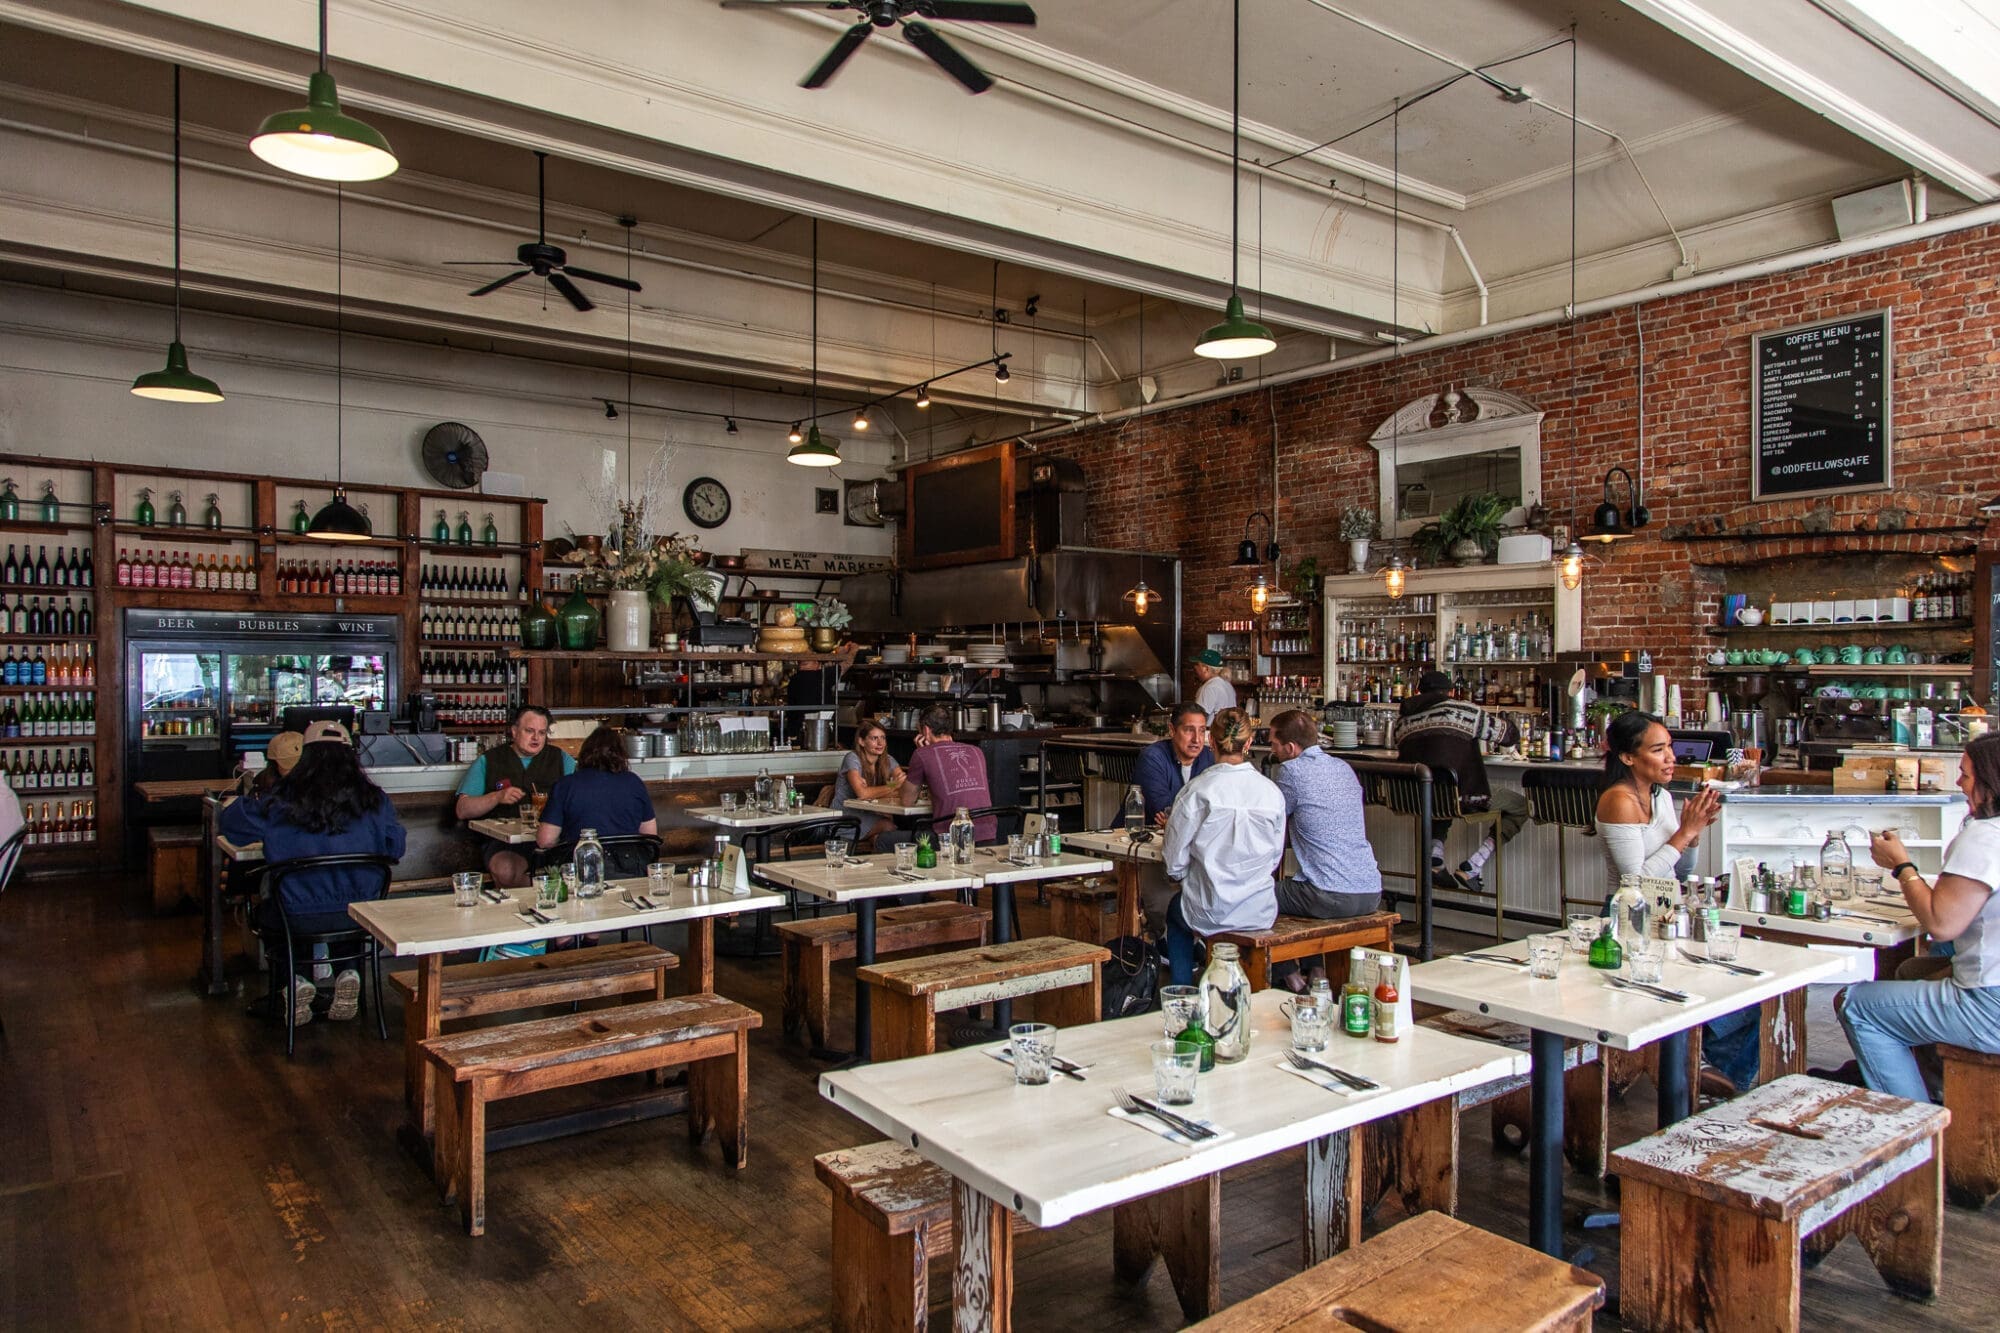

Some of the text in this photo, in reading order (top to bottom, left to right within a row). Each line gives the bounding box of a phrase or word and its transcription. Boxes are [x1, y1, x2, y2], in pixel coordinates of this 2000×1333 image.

[1786, 325, 1851, 346] COFFEE MENU
[1806, 368, 1823, 376] LATTE
[1832, 370, 1852, 378] LATTE
[1809, 429, 1827, 437] LATTE
[1771, 455, 1870, 475] @ODDFELLOWSCAFE
[768, 557, 884, 572] MEAT MARKET
[158, 618, 195, 629] BEER
[238, 620, 299, 631] BUBBLES
[337, 622, 374, 632] WINE
